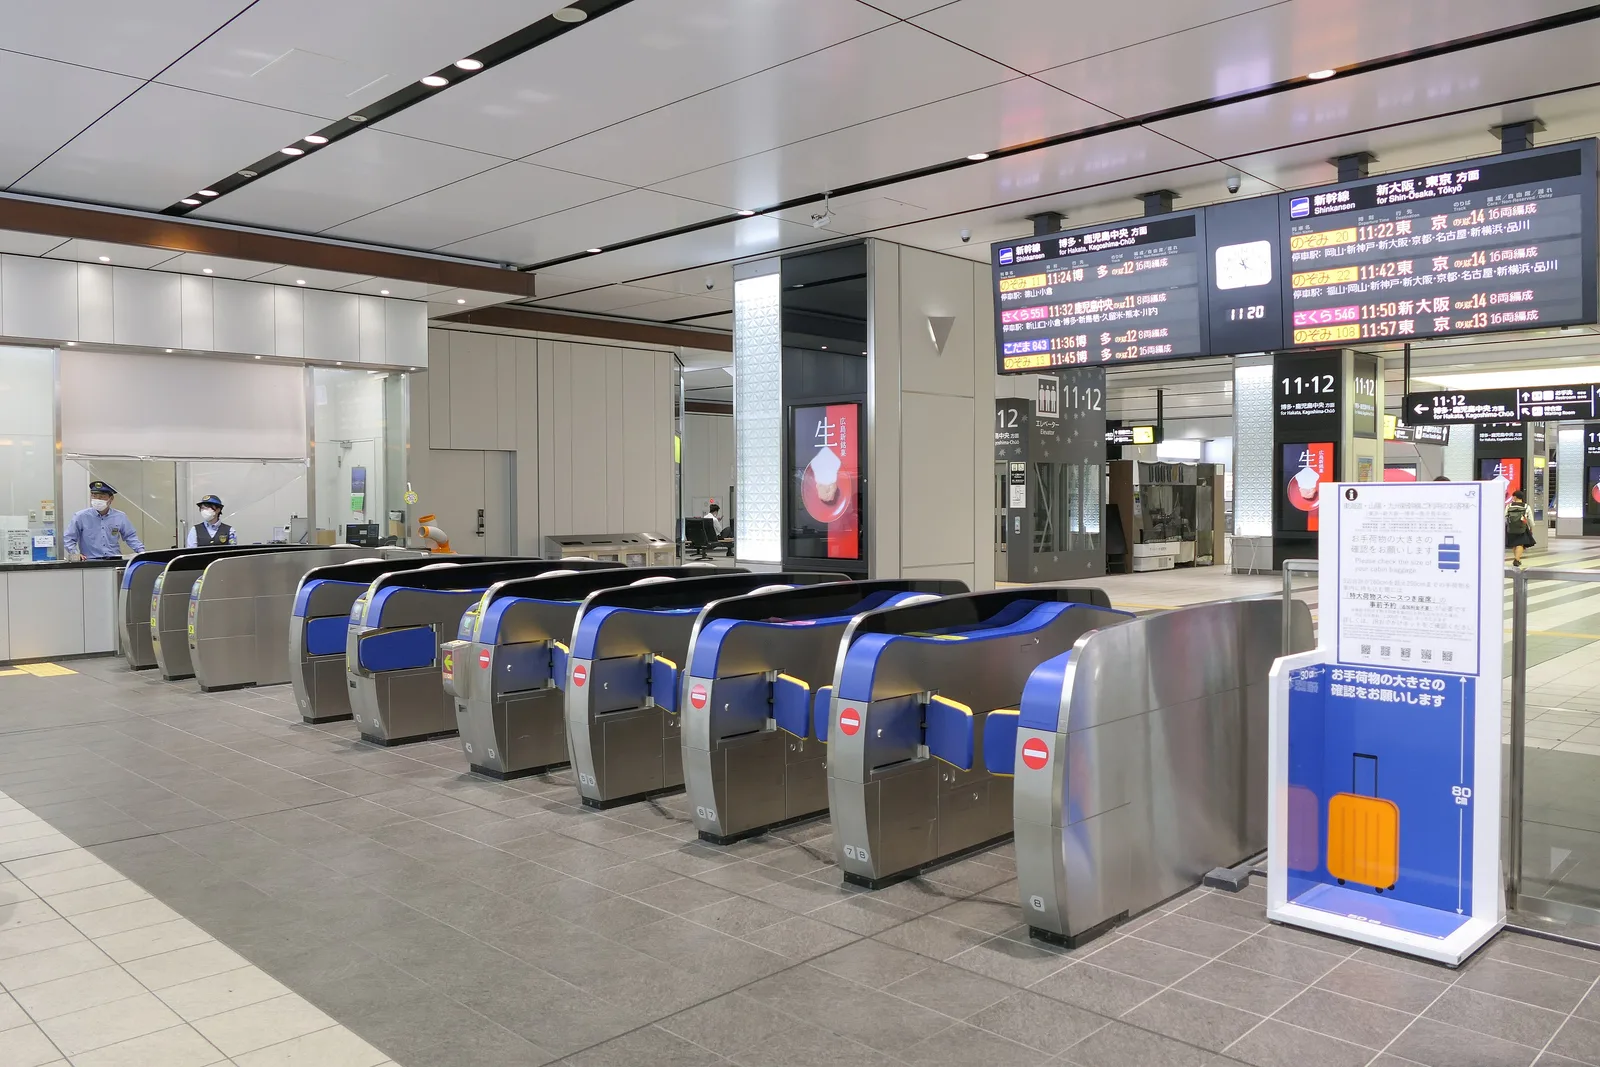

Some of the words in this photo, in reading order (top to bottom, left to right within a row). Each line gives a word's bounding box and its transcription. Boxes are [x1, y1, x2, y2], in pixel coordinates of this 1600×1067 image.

[1456, 170, 1480, 183] 方面
[1314, 191, 1350, 206] 新幹線
[1314, 202, 1355, 215] Shinkansen
[1131, 226, 1148, 237] 方面
[1292, 234, 1328, 248] のぞみ
[1336, 231, 1349, 242] 20
[1359, 222, 1393, 241] 11:22
[1016, 243, 1040, 255] 新幹線
[1016, 253, 1045, 263] Shinkansen
[1001, 279, 1027, 290] のぞみ
[1048, 271, 1071, 285] 11:24
[1293, 272, 1330, 286] のぞみ
[1337, 270, 1350, 281] 22
[1360, 262, 1395, 280] 11:42
[1002, 310, 1029, 323] さくら
[1030, 308, 1044, 319] 551
[1049, 304, 1073, 318] 11:32
[1295, 310, 1332, 325] さくら
[1335, 308, 1355, 320] 546
[1361, 303, 1396, 319] 11:50
[1295, 328, 1332, 342] のぞみ
[1337, 327, 1355, 338] 108
[1362, 321, 1396, 338] 11:57
[1004, 342, 1030, 354] こだま
[1032, 340, 1047, 351] 843
[1051, 336, 1075, 350] 11:36
[1005, 357, 1031, 368] のぞみ
[1052, 352, 1076, 366] 11:45
[814, 417, 837, 447] 生
[1298, 450, 1317, 467] 生
[1493, 463, 1508, 476] 生
[1331, 669, 1445, 691] お手荷物の大きさの
[1331, 683, 1445, 707] 確認をお願いします
[1452, 786, 1471, 798] 80
